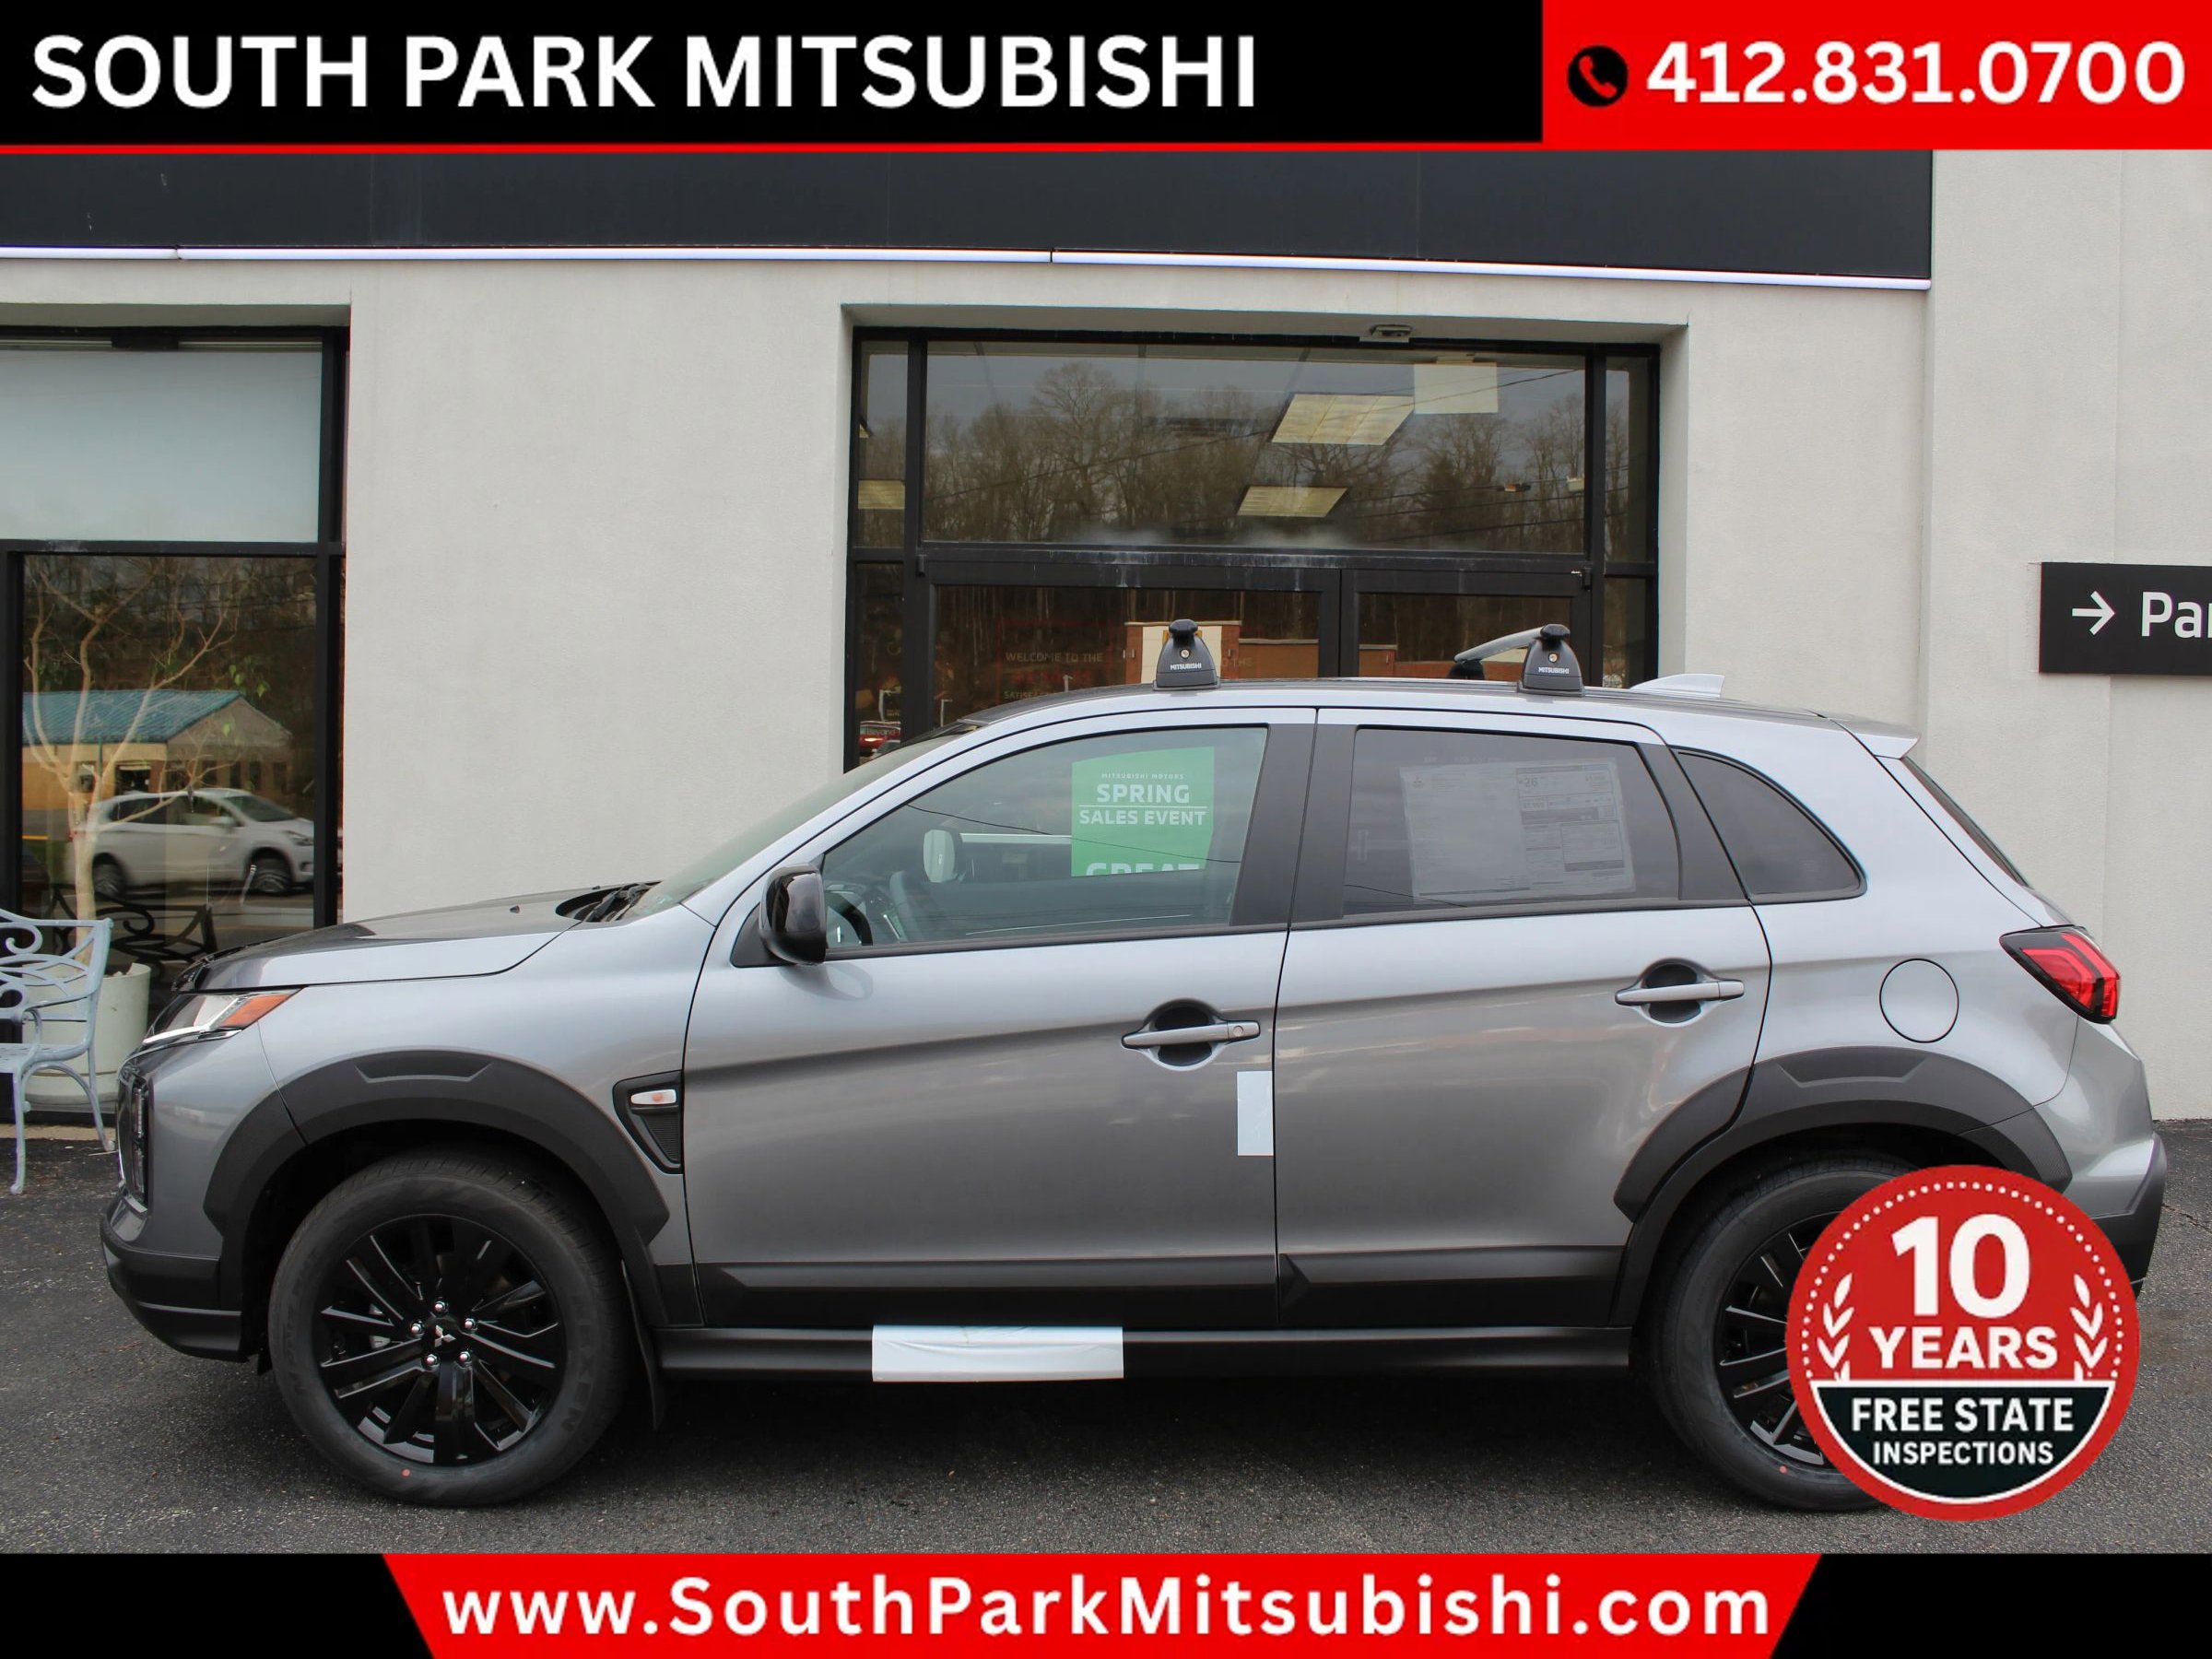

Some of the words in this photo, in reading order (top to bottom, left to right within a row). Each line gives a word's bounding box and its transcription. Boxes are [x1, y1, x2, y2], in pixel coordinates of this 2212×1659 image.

[2141, 591, 2212, 639] Pa
[1005, 651, 1061, 663] WELCOME
[1083, 652, 1104, 663] THE
[1537, 666, 1570, 675] MITSUBISHI
[1097, 783, 1190, 804] SPRING
[1079, 809, 1138, 825] SALES
[1144, 810, 1206, 826] EVENT
